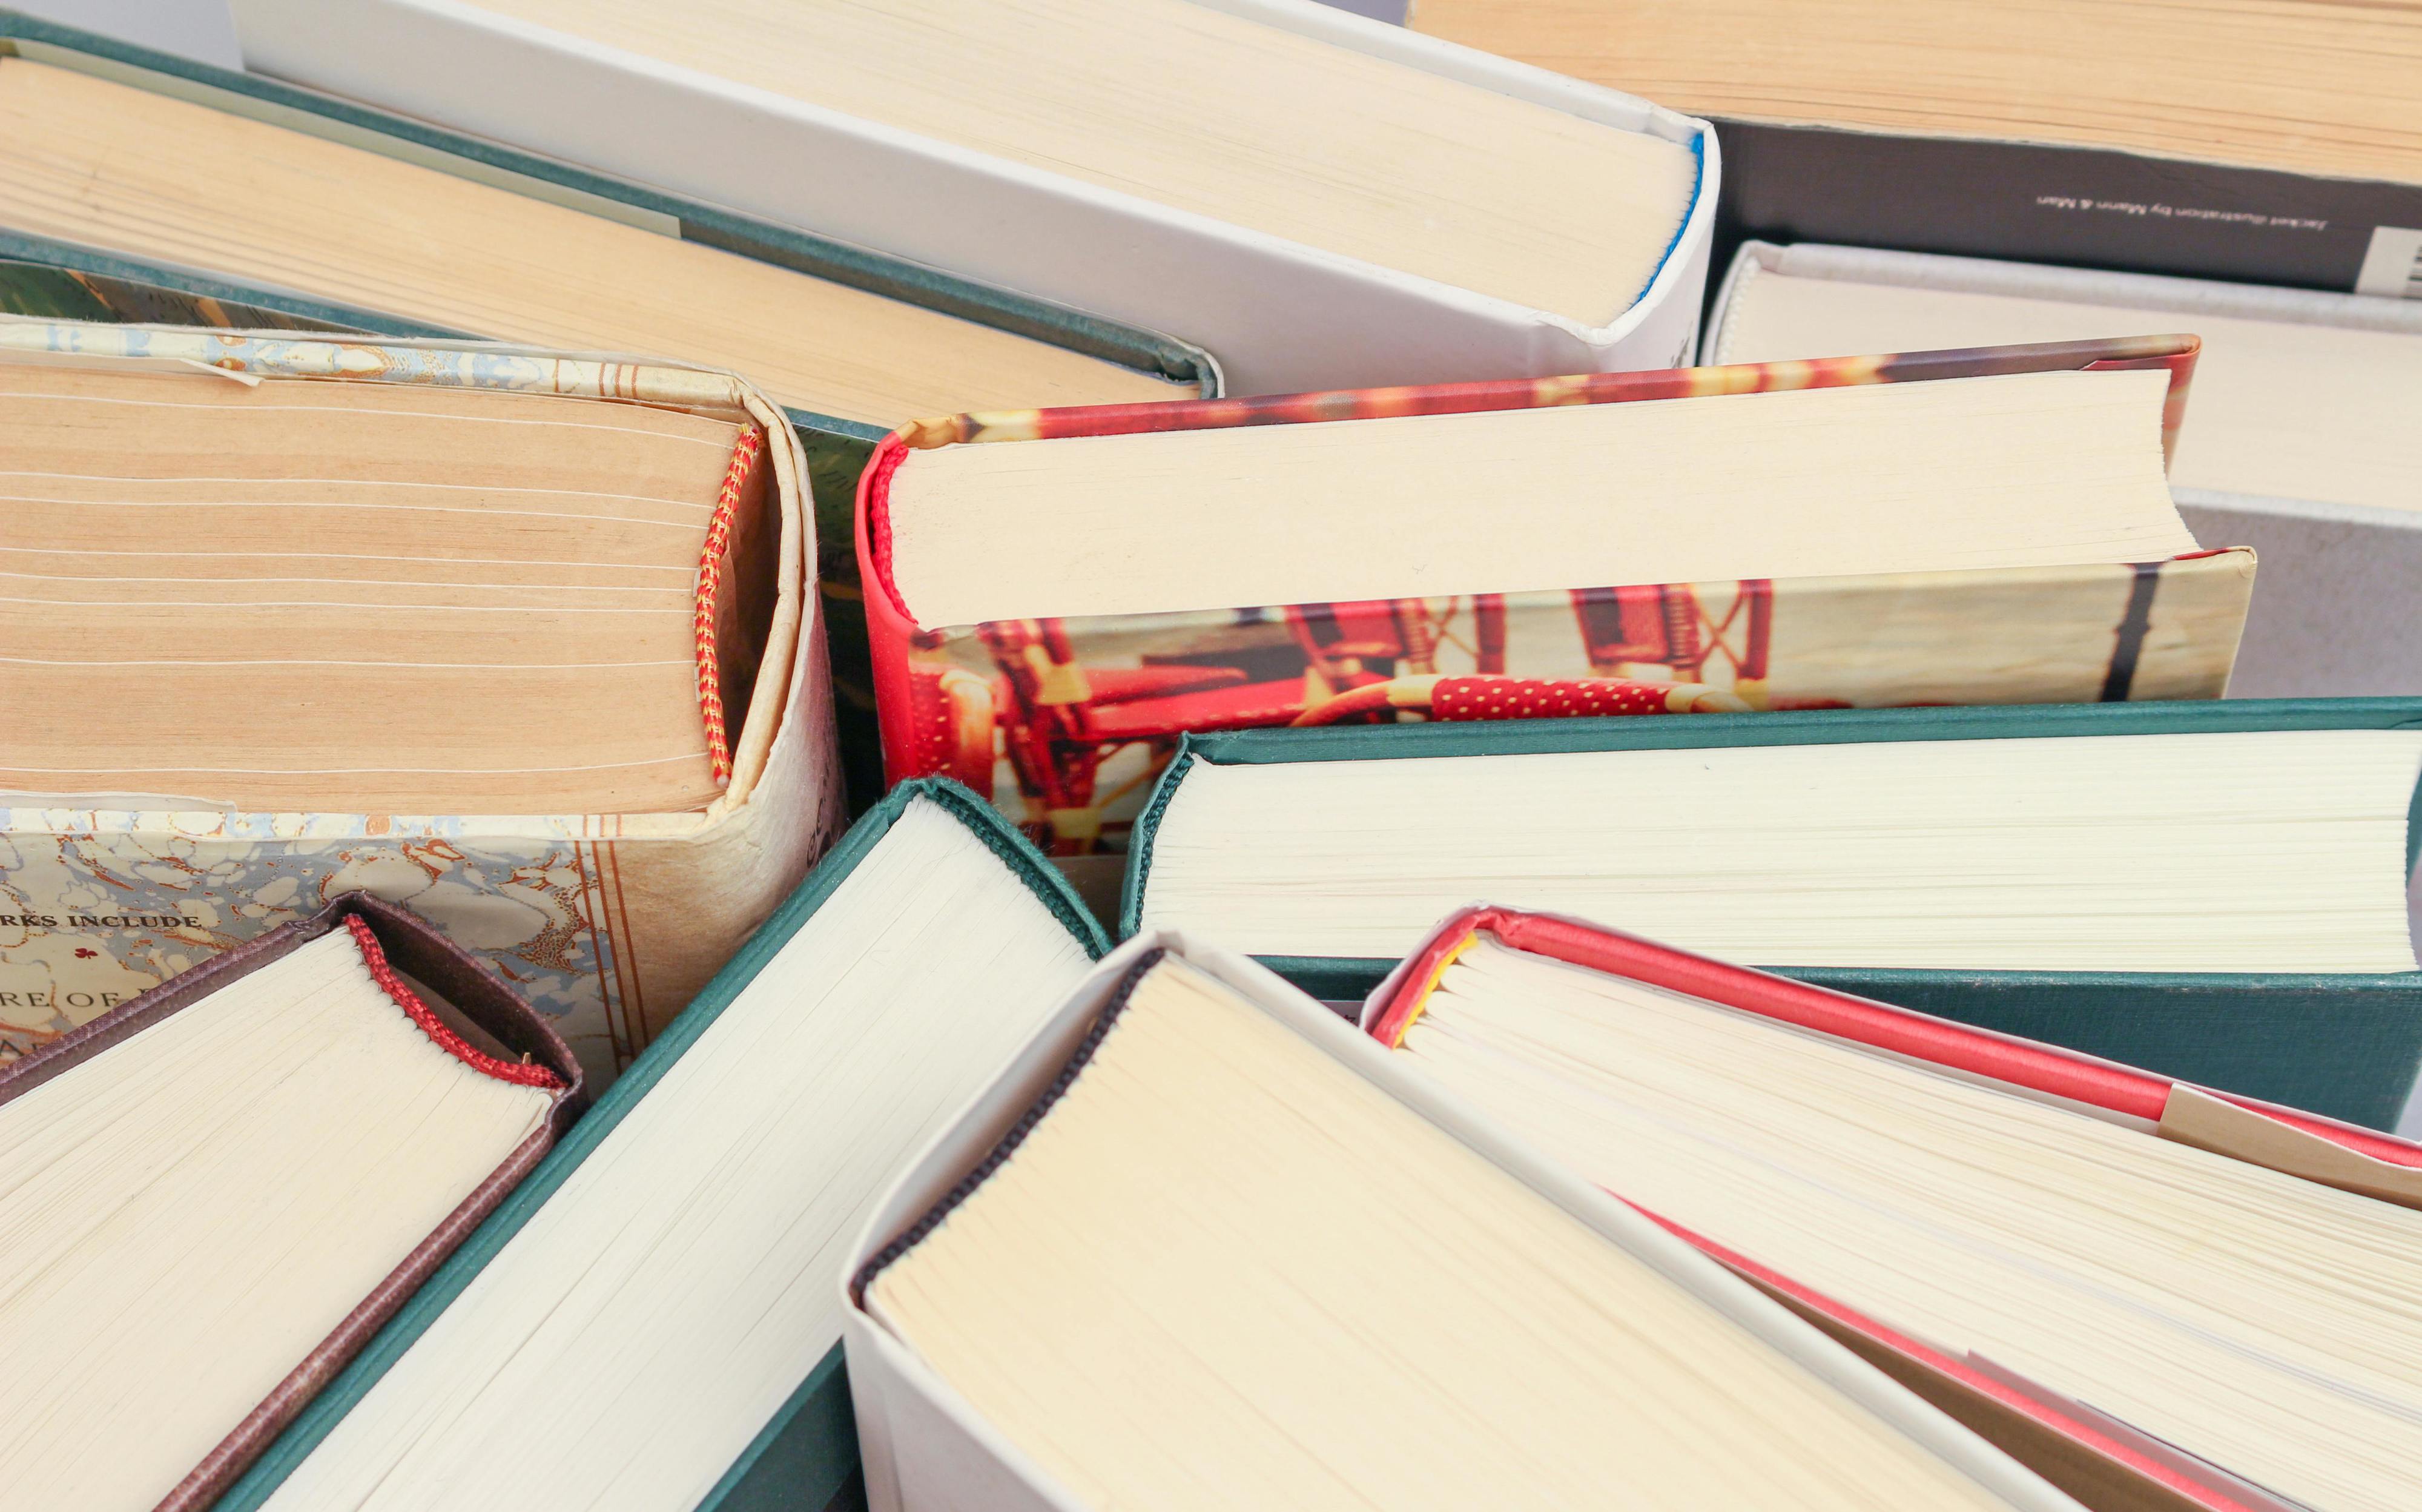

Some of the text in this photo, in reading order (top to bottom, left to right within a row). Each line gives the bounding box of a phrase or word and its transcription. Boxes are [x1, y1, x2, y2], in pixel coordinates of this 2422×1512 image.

[2080, 199, 2093, 210] &
[2096, 201, 2147, 215] Mann
[2150, 203, 2173, 217] by
[2176, 208, 2268, 225] illustration
[2271, 216, 2328, 231] Jacket
[0, 915, 202, 928] RKS INCLUDE
[0, 992, 119, 1007] RE OF
